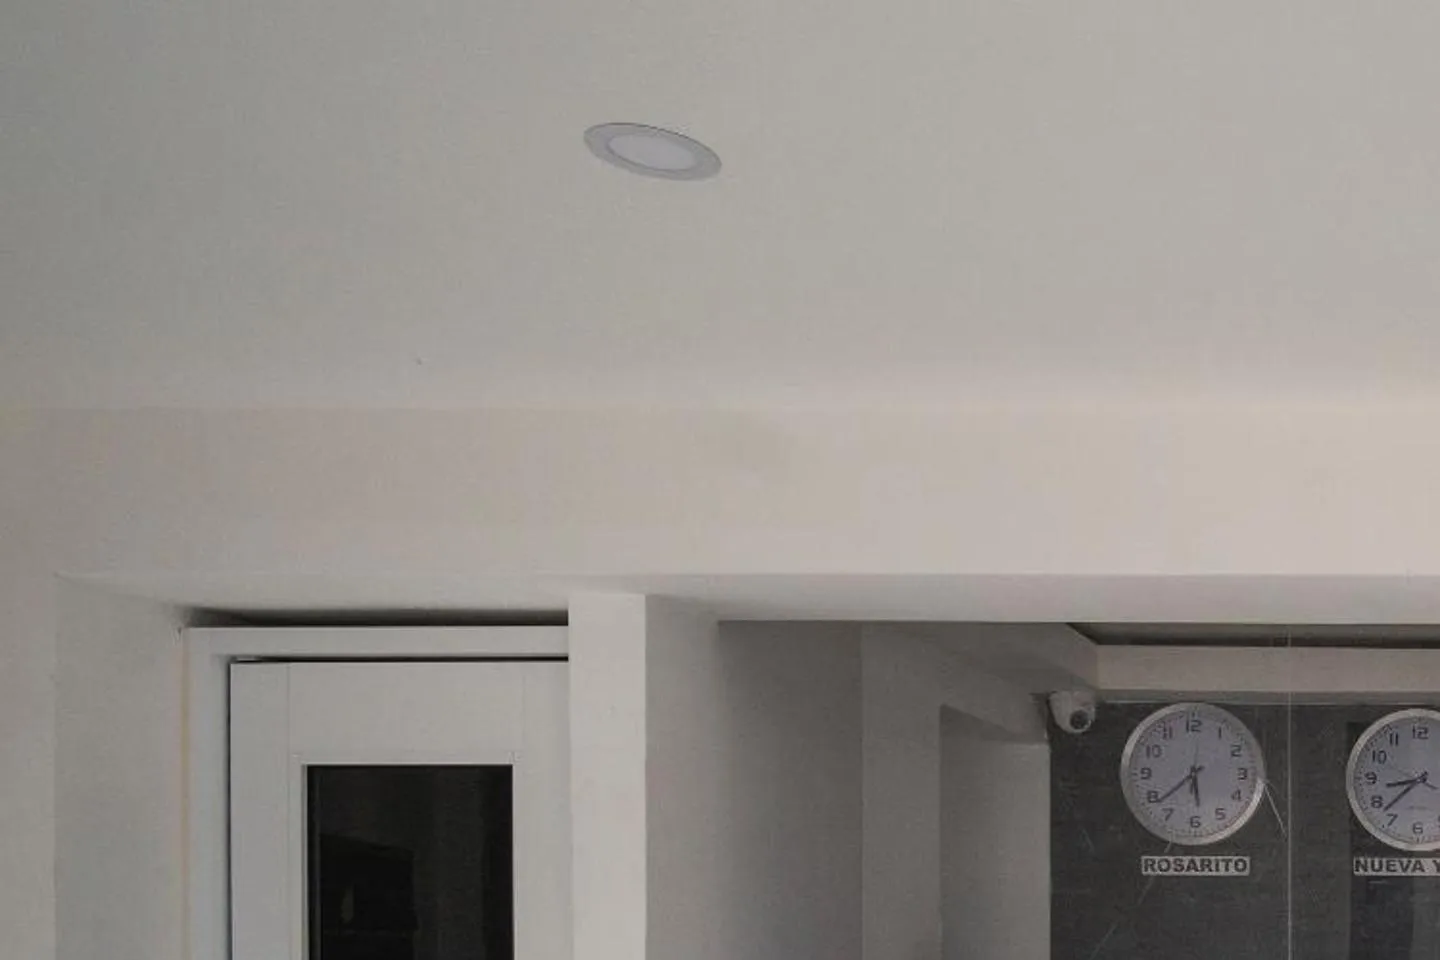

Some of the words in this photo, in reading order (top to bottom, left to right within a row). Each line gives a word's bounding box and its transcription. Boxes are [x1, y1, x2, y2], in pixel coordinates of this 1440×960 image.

[1163, 727, 1173, 739] 11
[1186, 720, 1201, 733] 12
[1217, 727, 1223, 739] 1
[1412, 726, 1429, 740] 12
[1389, 733, 1399, 746] 11
[1145, 744, 1162, 758] 10
[1231, 745, 1242, 757] 2
[1372, 750, 1387, 765] 10
[1140, 767, 1152, 780] 9
[1237, 768, 1248, 780] 3
[1364, 771, 1377, 785] 9
[1147, 790, 1159, 803] 8
[1231, 789, 1241, 801] 4
[1370, 795, 1383, 809] 8
[1162, 808, 1175, 821] 7
[1215, 808, 1226, 820] 5
[1386, 813, 1398, 827] 7
[1190, 816, 1201, 828] 6
[1412, 822, 1423, 835] 6
[1142, 857, 1249, 874] ROSARITO
[1353, 858, 1427, 874] NUEVA
